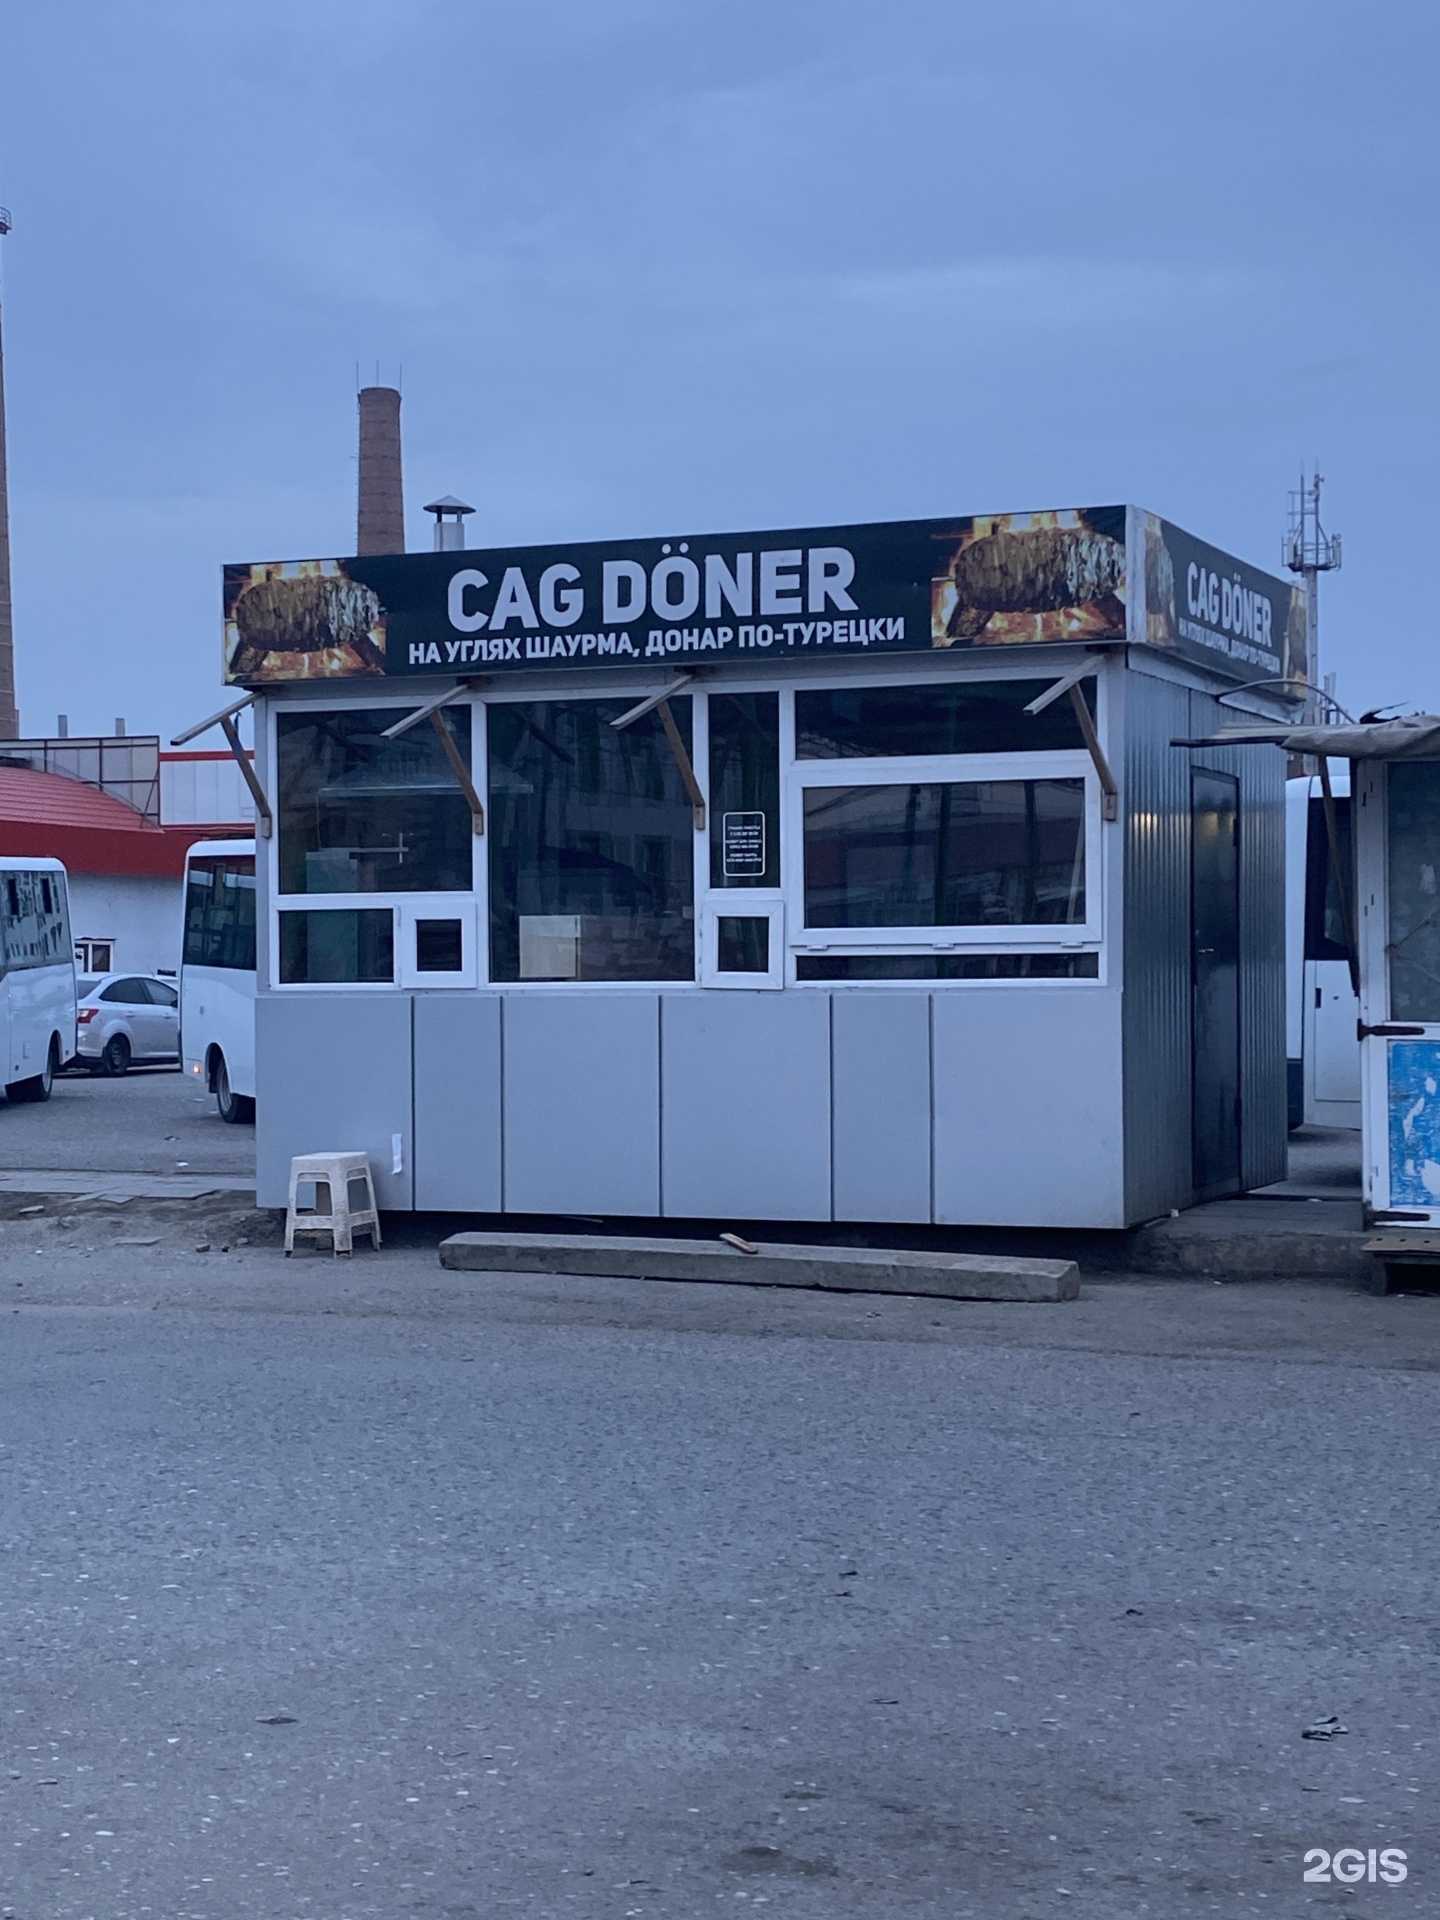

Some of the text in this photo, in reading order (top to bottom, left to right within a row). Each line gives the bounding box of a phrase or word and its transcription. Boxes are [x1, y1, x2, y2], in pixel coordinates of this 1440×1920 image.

[447, 542, 860, 633] CAG DÖNER
[1187, 561, 1220, 625] CAG
[1221, 572, 1273, 648] DÖNER
[408, 616, 905, 665] НА УГЛЯХ ШАУРМА, ДОНАР ПО-ТУРЕЦКИ
